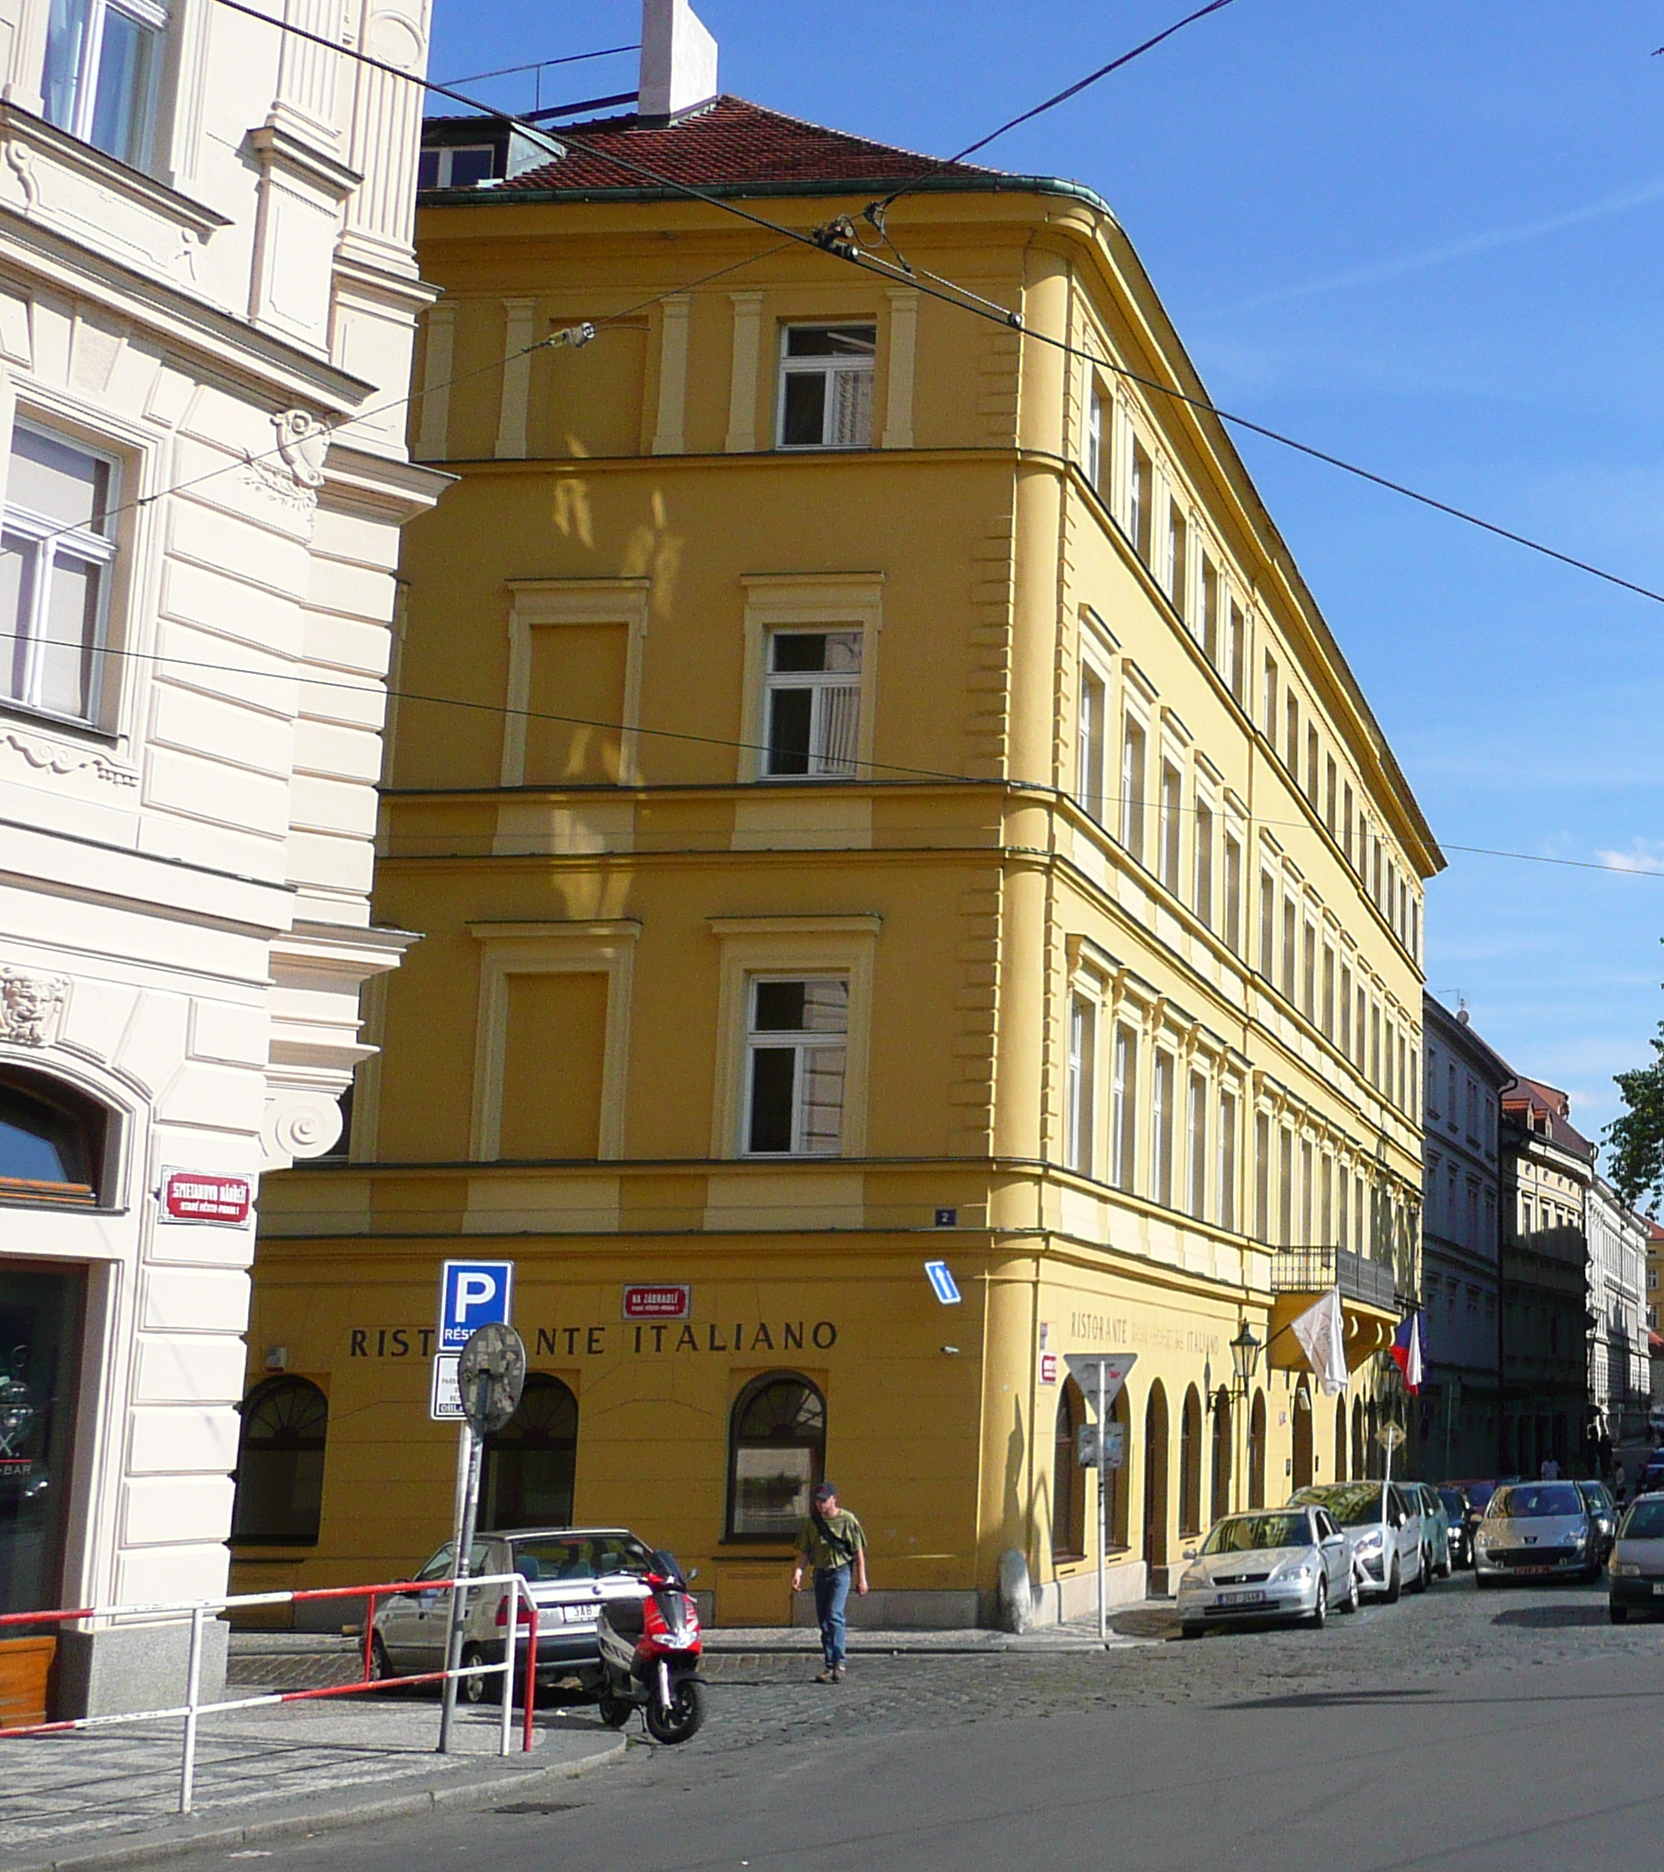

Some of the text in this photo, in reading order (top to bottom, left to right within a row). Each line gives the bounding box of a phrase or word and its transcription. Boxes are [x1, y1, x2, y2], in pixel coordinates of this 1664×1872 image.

[455, 1272, 496, 1323] P
[350, 1321, 838, 1357] RISTNTE ITALIANO
[1071, 1312, 1128, 1345] RISTORANTE
